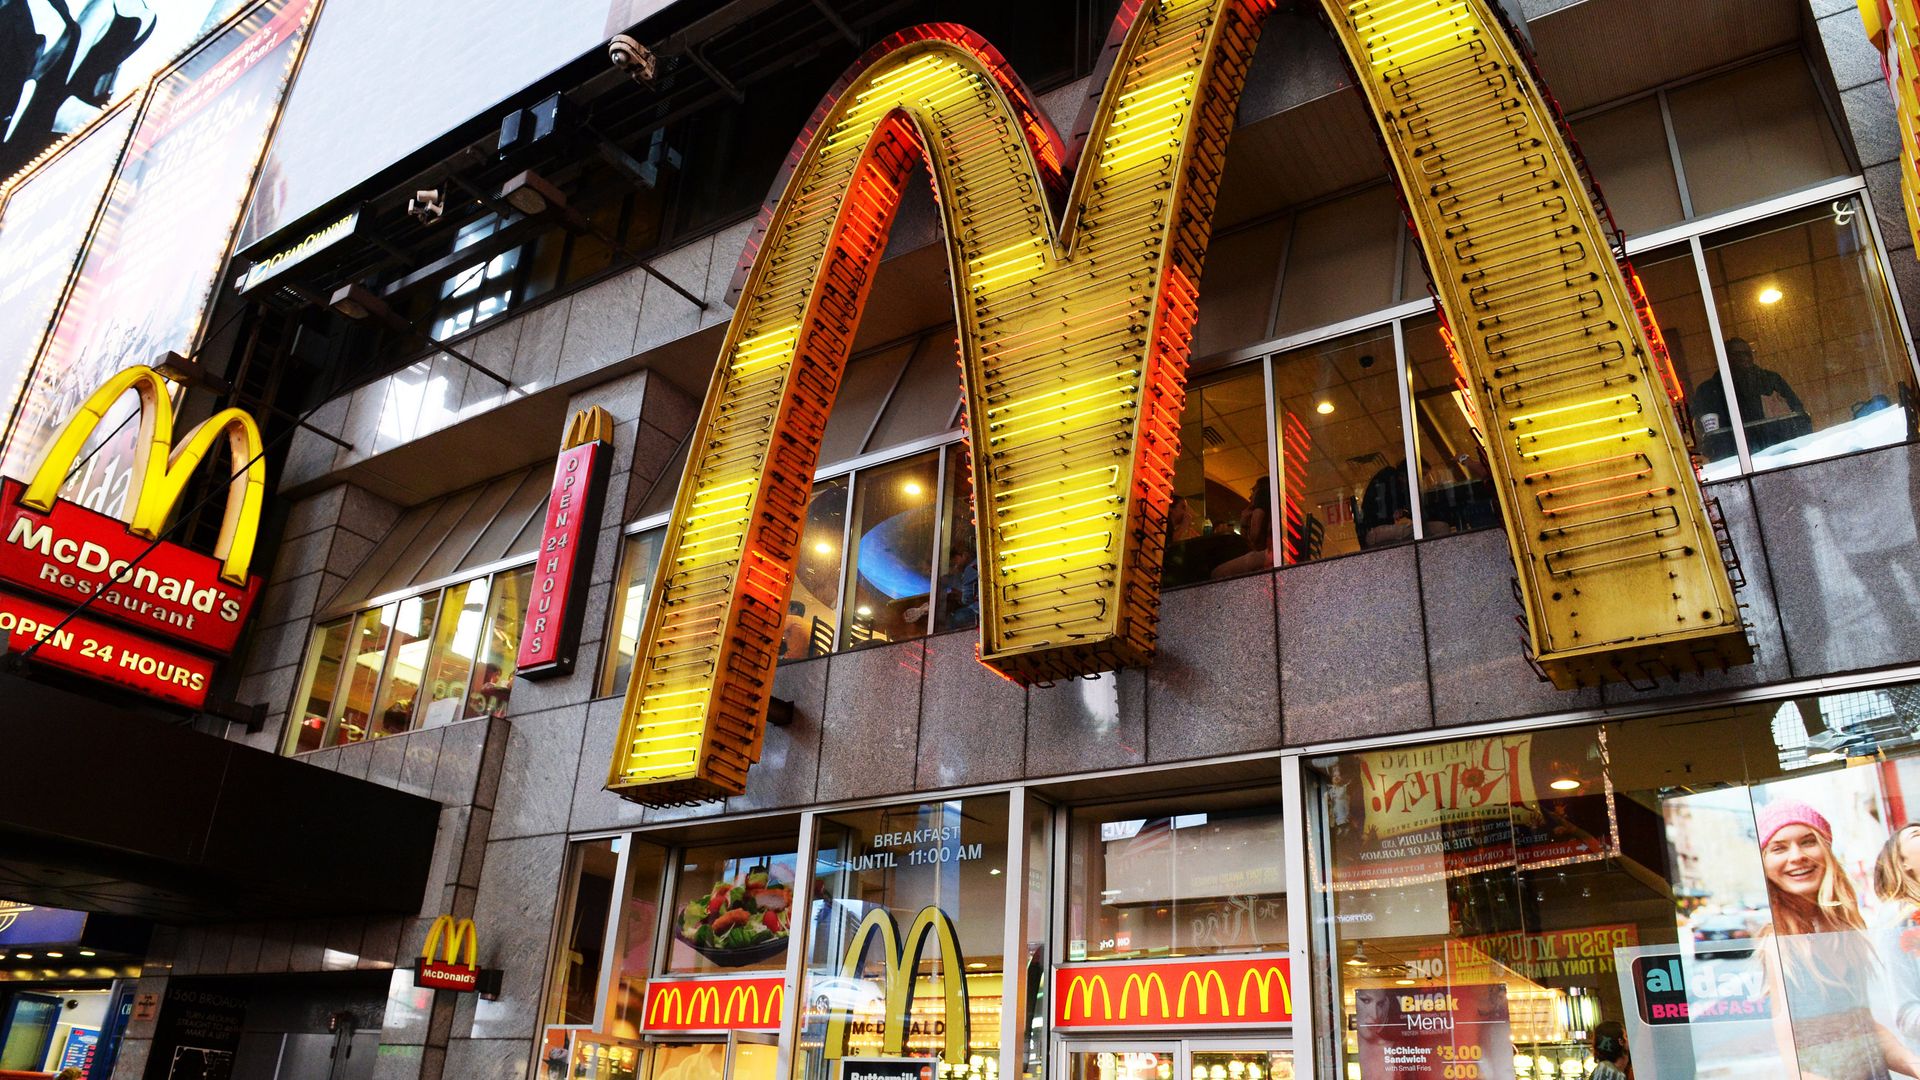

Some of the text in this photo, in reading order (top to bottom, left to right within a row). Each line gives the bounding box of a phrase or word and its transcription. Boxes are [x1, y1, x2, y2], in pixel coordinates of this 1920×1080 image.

[529, 456, 579, 656] OPEN 24 HOURS
[5, 515, 242, 624] McDonald's
[39, 561, 198, 633] Restaurant
[0, 611, 206, 692] OPEN 24 HOURS
[874, 826, 961, 848] BREAKFAST
[852, 843, 983, 872] UNTIL 11:00 AM
[422, 968, 476, 984] McDonald's
[1646, 959, 1764, 1000] al day
[1401, 994, 1459, 1013] Break
[1406, 1013, 1455, 1031] Menu
[1384, 1055, 1427, 1064] Sandwich
[1436, 1045, 1482, 1061] $3.00
[1384, 1063, 1432, 1073] with Small Fries
[1443, 1064, 1479, 1079] 600
